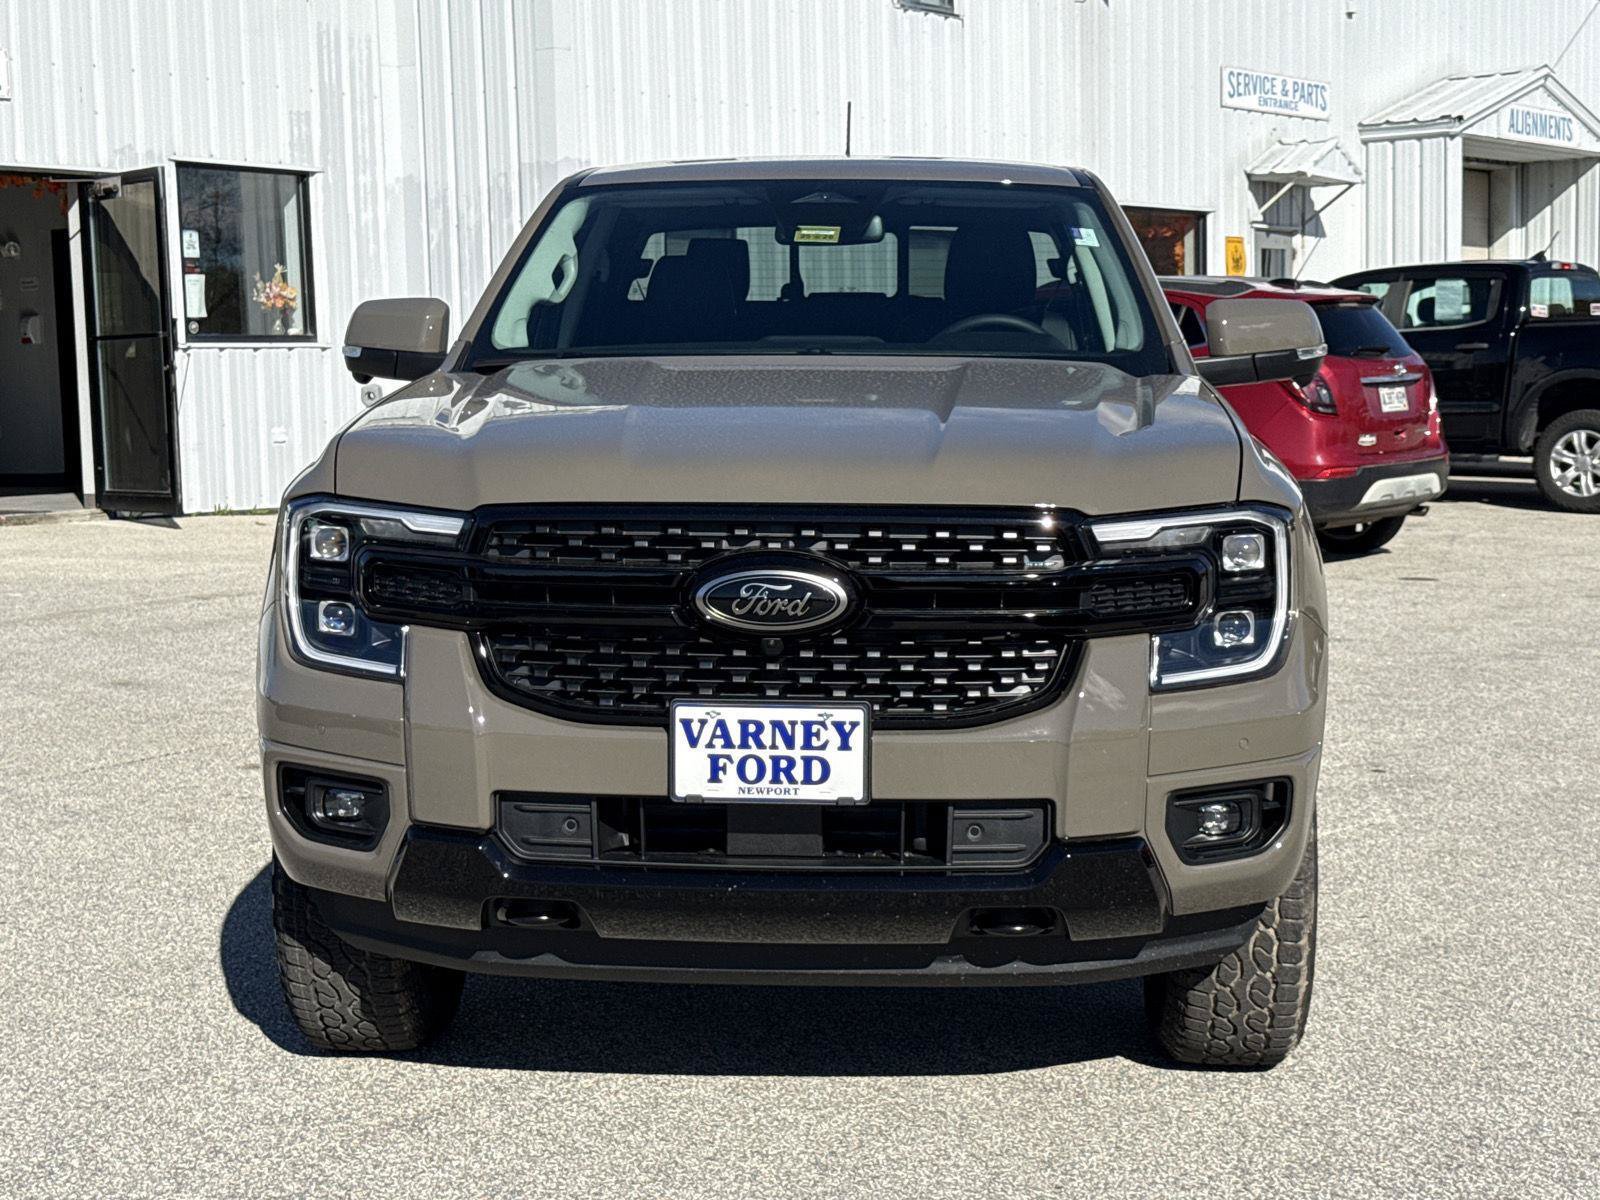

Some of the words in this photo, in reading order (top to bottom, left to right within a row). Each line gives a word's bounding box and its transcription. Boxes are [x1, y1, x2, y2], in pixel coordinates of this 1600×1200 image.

[1228, 71, 1278, 98] SERVICE
[1280, 78, 1290, 97] &
[1292, 81, 1328, 112] PARTS
[1258, 96, 1300, 112] ENTRANCE
[1508, 108, 1573, 142] ALIGNMENTS
[731, 582, 812, 616] Ford
[679, 718, 860, 751] VARNEY
[707, 753, 831, 785] FORD
[738, 786, 800, 796] NEWPORT
